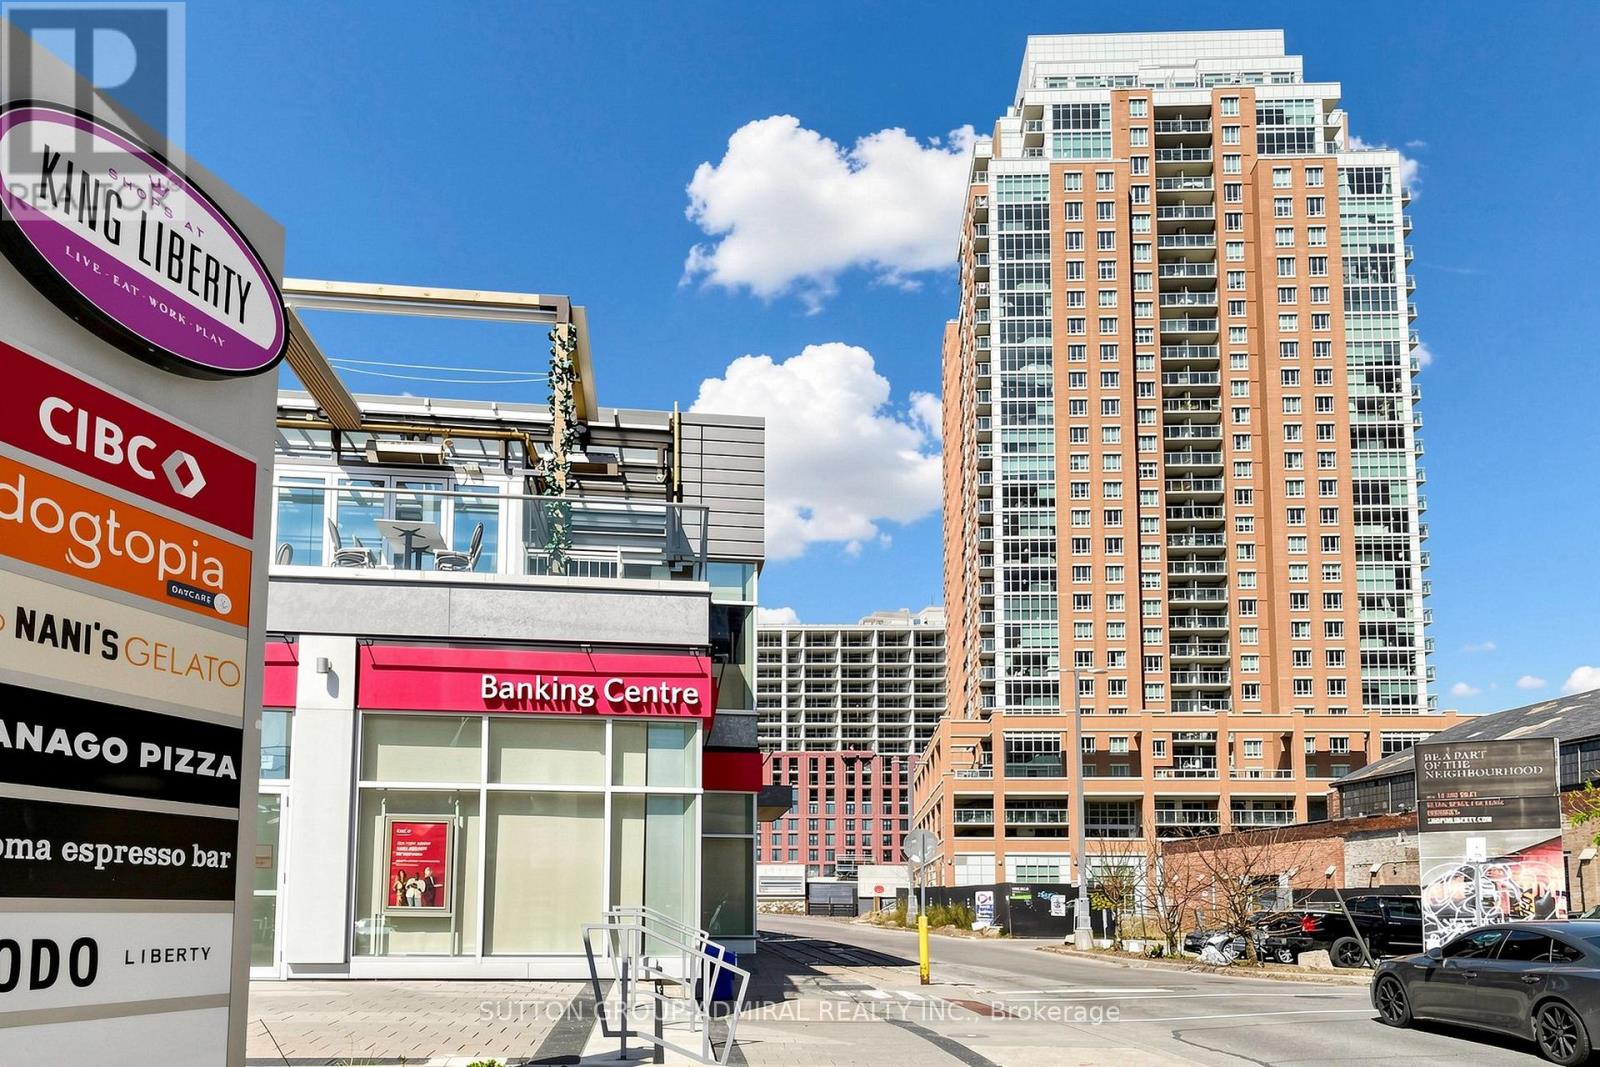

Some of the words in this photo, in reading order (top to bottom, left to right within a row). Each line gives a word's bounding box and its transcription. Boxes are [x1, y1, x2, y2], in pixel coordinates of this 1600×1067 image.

[108, 168, 173, 219] SHOPS
[184, 221, 205, 238] AT
[40, 144, 122, 246] KING
[138, 210, 252, 324] LIBERTY
[39, 396, 157, 480] CIBC
[0, 474, 224, 590] dogtopia
[15, 606, 119, 661] NANI'S
[124, 637, 241, 687] GELATO
[481, 673, 595, 707] Banking
[604, 677, 699, 704] Centre
[140, 742, 237, 780] PIZZA
[1425, 765, 1544, 779] NEIGHBOURHOOD
[61, 841, 186, 870] espresso
[192, 844, 232, 869] bar
[125, 947, 211, 965] LIBERTY
